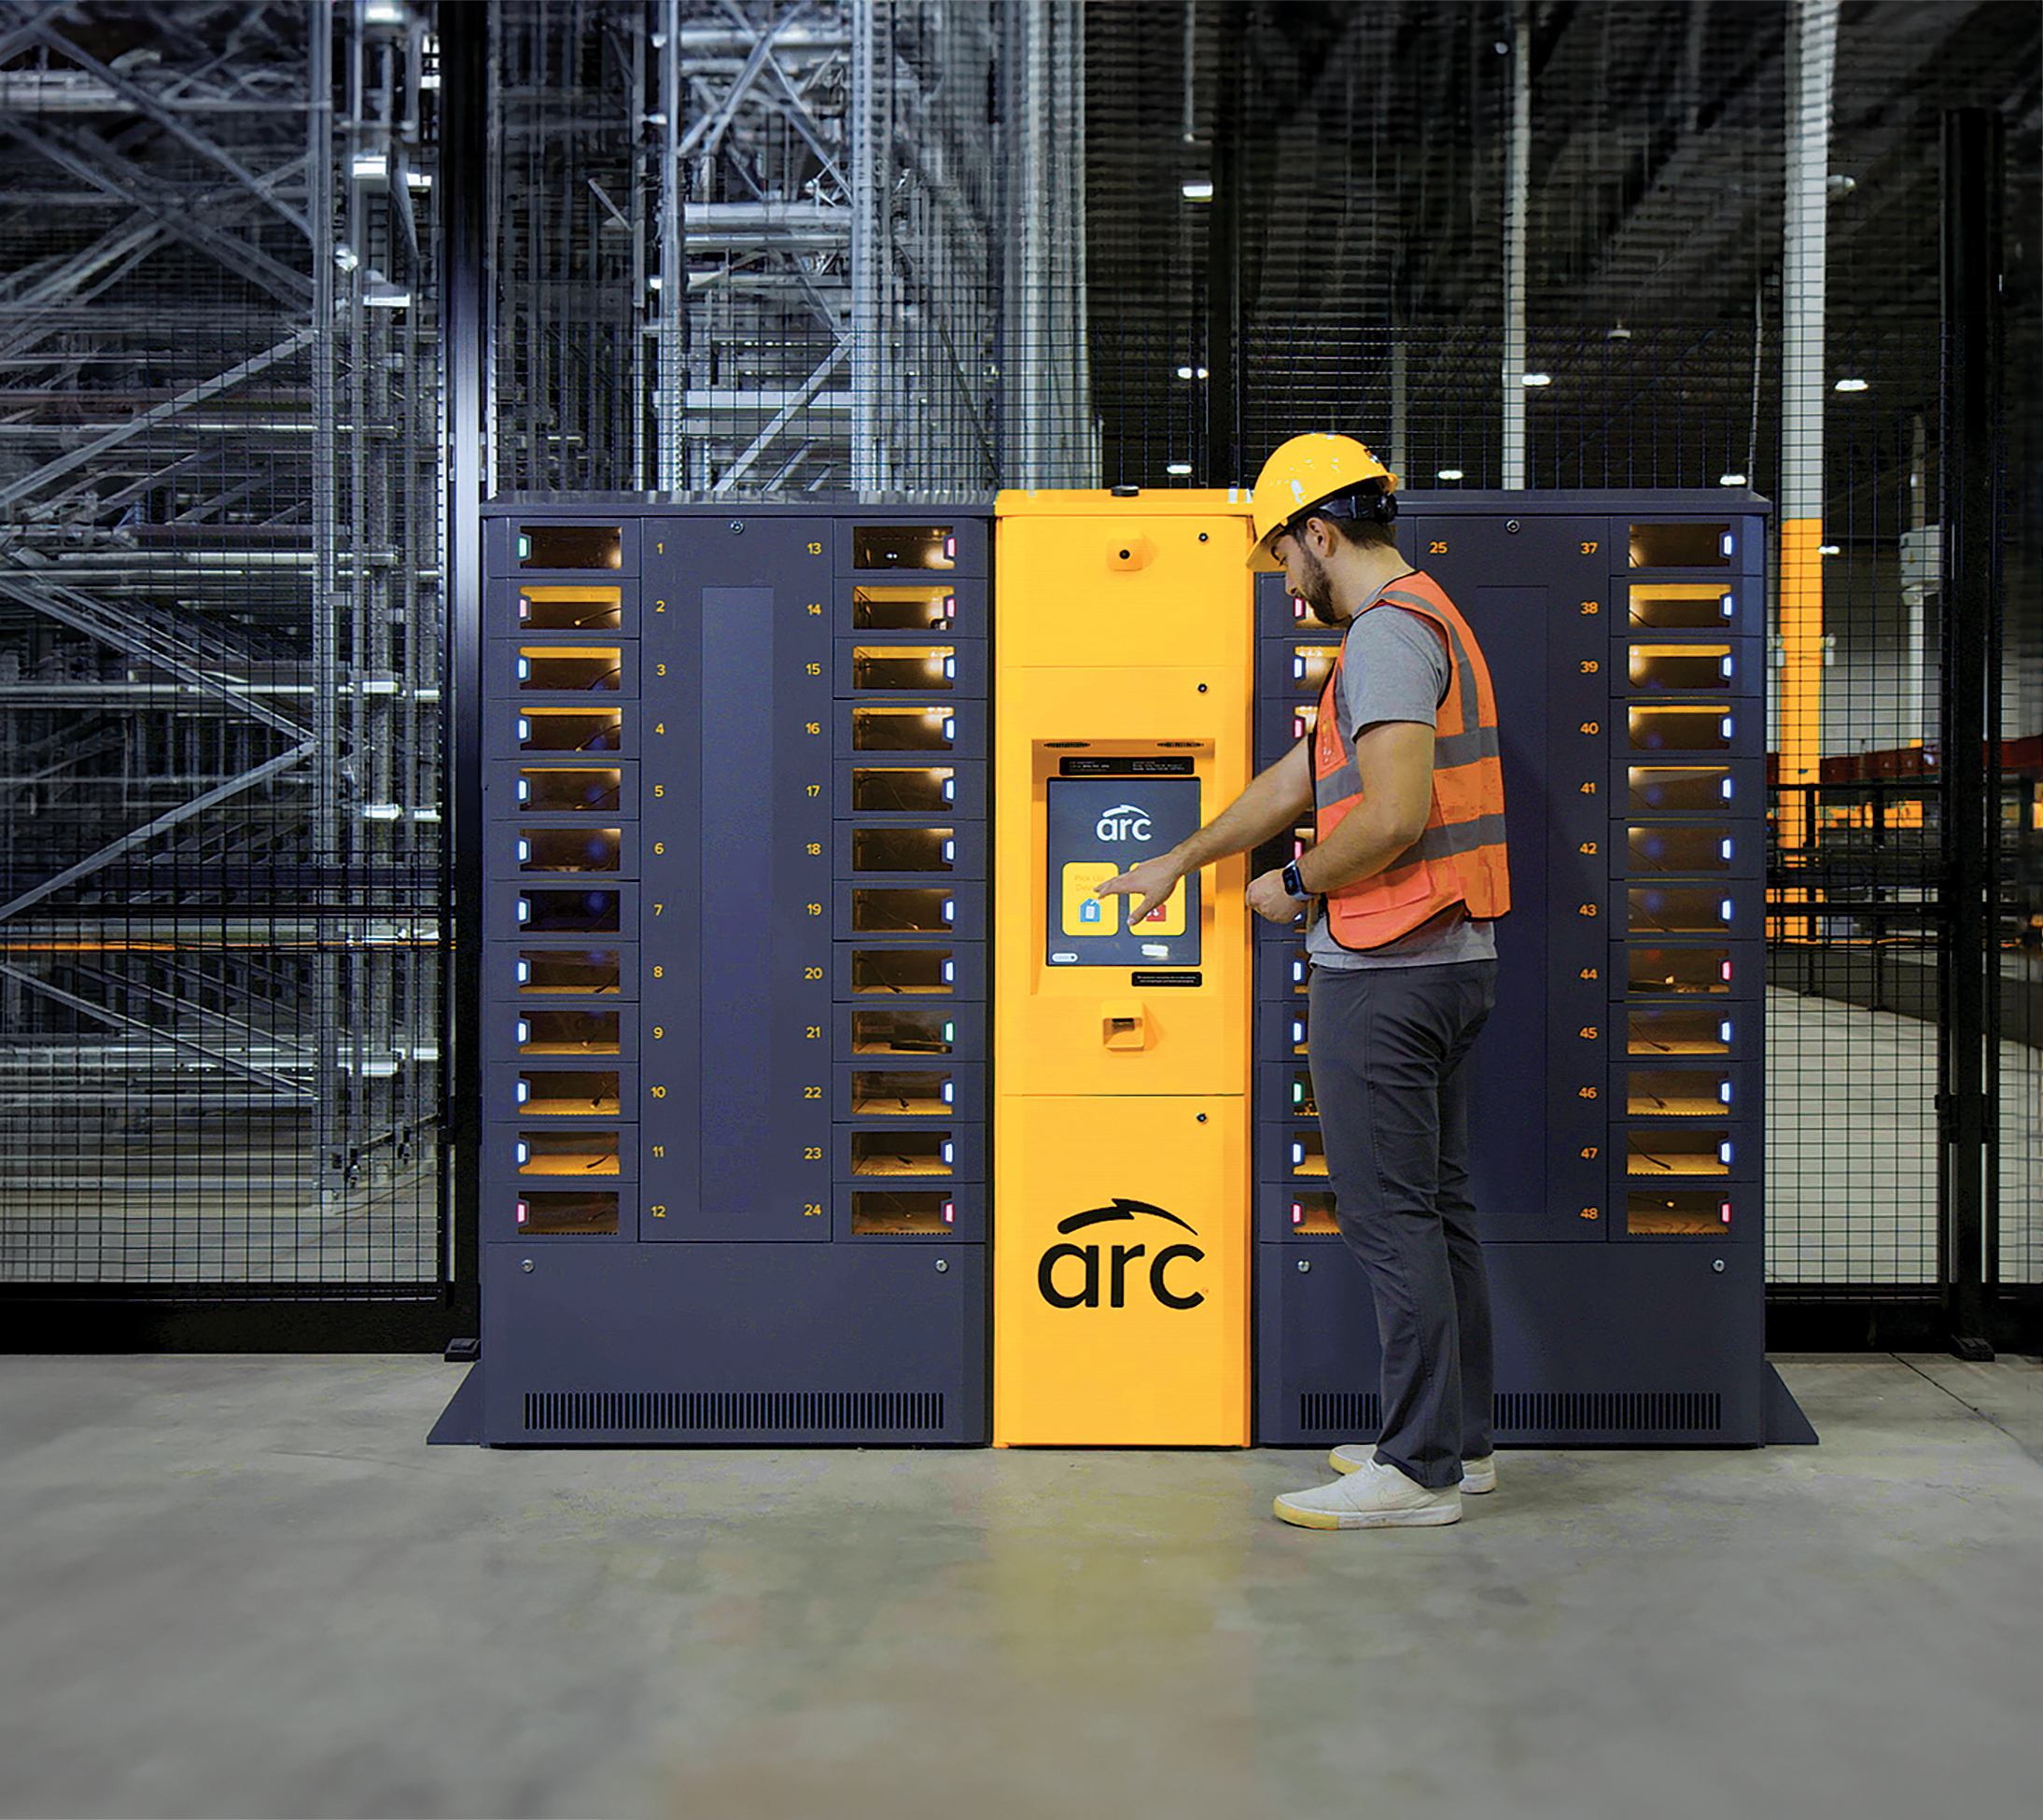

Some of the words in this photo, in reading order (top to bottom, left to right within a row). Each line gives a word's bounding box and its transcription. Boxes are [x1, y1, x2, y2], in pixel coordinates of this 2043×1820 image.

[656, 543, 664, 554] 1
[806, 542, 822, 555] 13
[1429, 541, 1448, 553] 25
[1581, 541, 1599, 554] 37
[655, 600, 665, 612] 2
[806, 603, 822, 615] 14
[1580, 601, 1599, 615] 38
[656, 664, 666, 677] 3
[805, 663, 821, 676] 15
[1580, 660, 1599, 673] 39
[655, 723, 665, 735] 4
[805, 722, 820, 735] 16
[1580, 721, 1600, 735] 40
[654, 784, 664, 798] 5
[805, 784, 820, 797] 17
[1580, 782, 1596, 794] 41
[1096, 818, 1152, 842] arc
[654, 842, 665, 855] 6
[805, 843, 821, 856] 18
[1579, 842, 1597, 855] 42
[653, 903, 664, 917] 7
[806, 903, 822, 916] 19
[1579, 903, 1597, 917] 43
[653, 965, 664, 978] 8
[805, 967, 823, 980] 20
[1580, 968, 1598, 980] 44
[653, 1027, 664, 1040] 9
[805, 1026, 820, 1039] 21
[1579, 1027, 1598, 1040] 45
[651, 1085, 666, 1099] 10
[804, 1086, 822, 1099] 22
[1578, 1086, 1597, 1099] 46
[652, 1146, 665, 1157] 11
[804, 1147, 822, 1160] 23
[1580, 1147, 1598, 1159] 47
[651, 1205, 666, 1218] 12
[804, 1203, 822, 1216] 24
[1580, 1207, 1598, 1220] 48
[1038, 1242, 1205, 1309] arc
